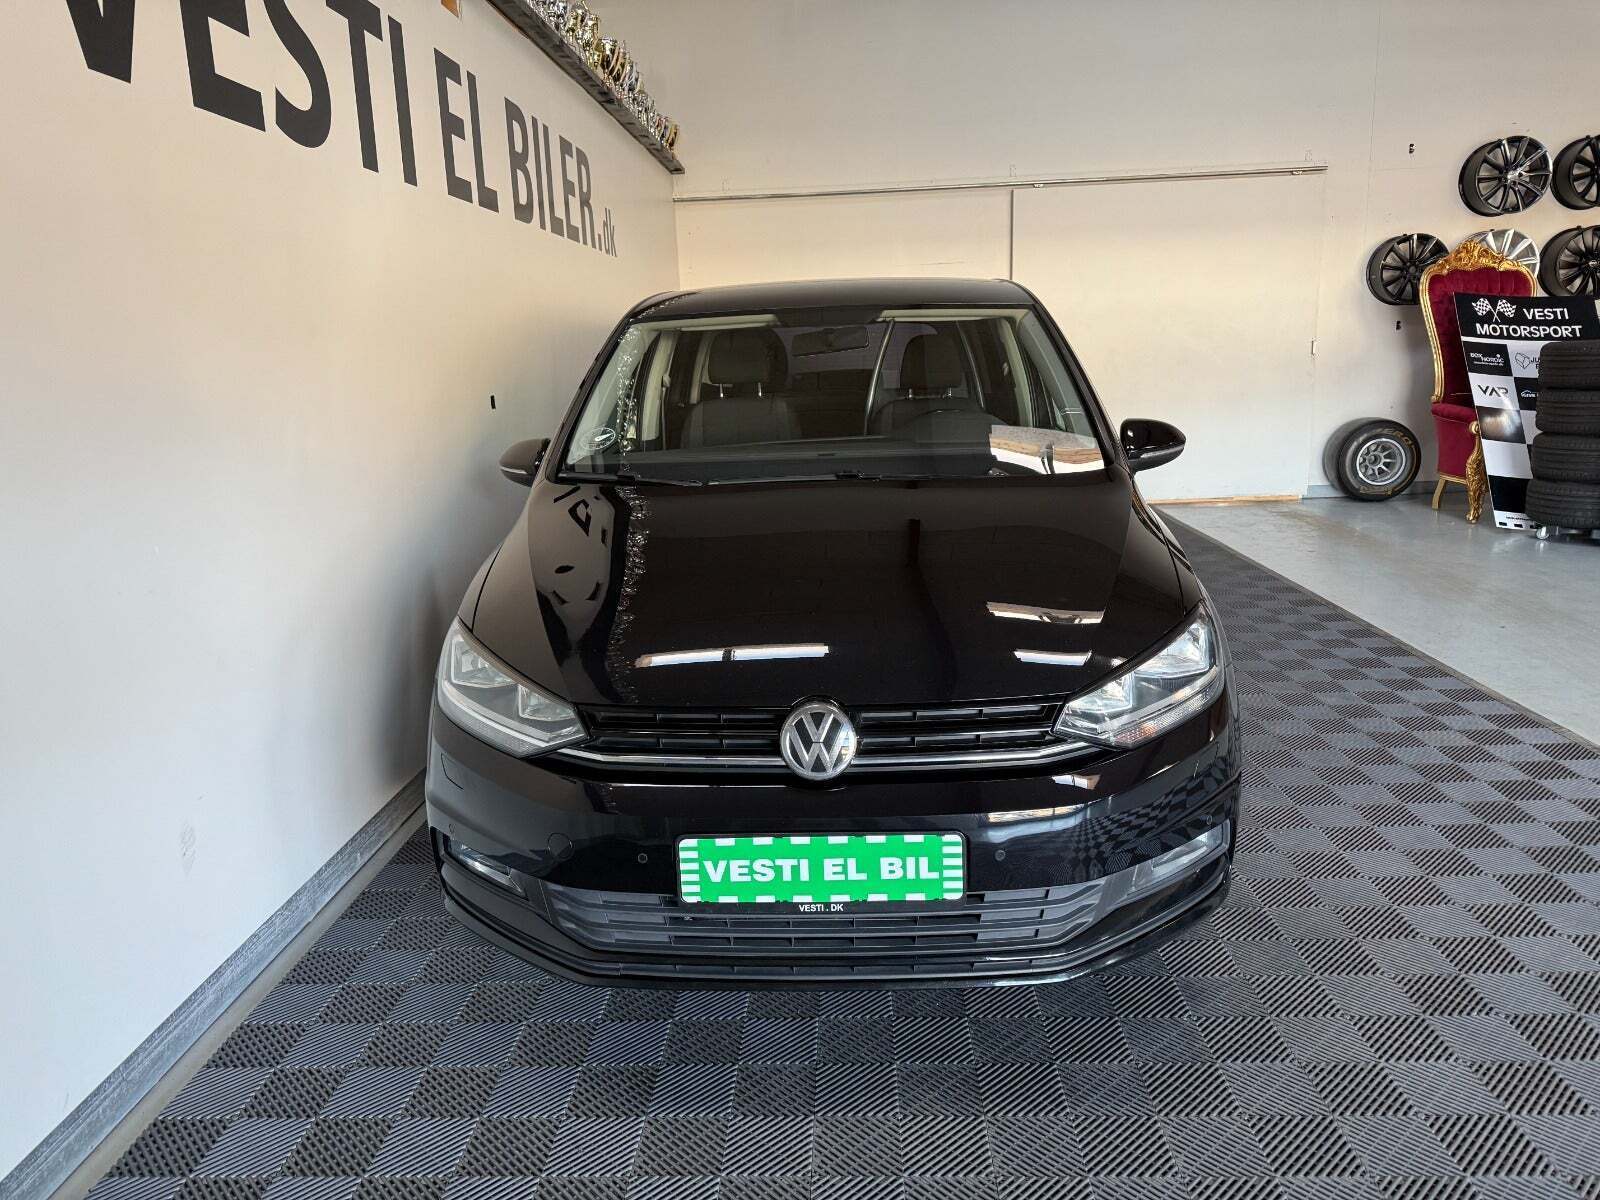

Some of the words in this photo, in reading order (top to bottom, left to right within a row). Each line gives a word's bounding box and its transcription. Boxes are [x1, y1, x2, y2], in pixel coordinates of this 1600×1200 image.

[434, 47, 499, 213] EL
[1523, 308, 1569, 320] VESTI
[1475, 323, 1582, 338] MOTORSPORT
[703, 858, 810, 883] VESTI
[823, 857, 867, 881] EL
[879, 856, 940, 880] BIL
